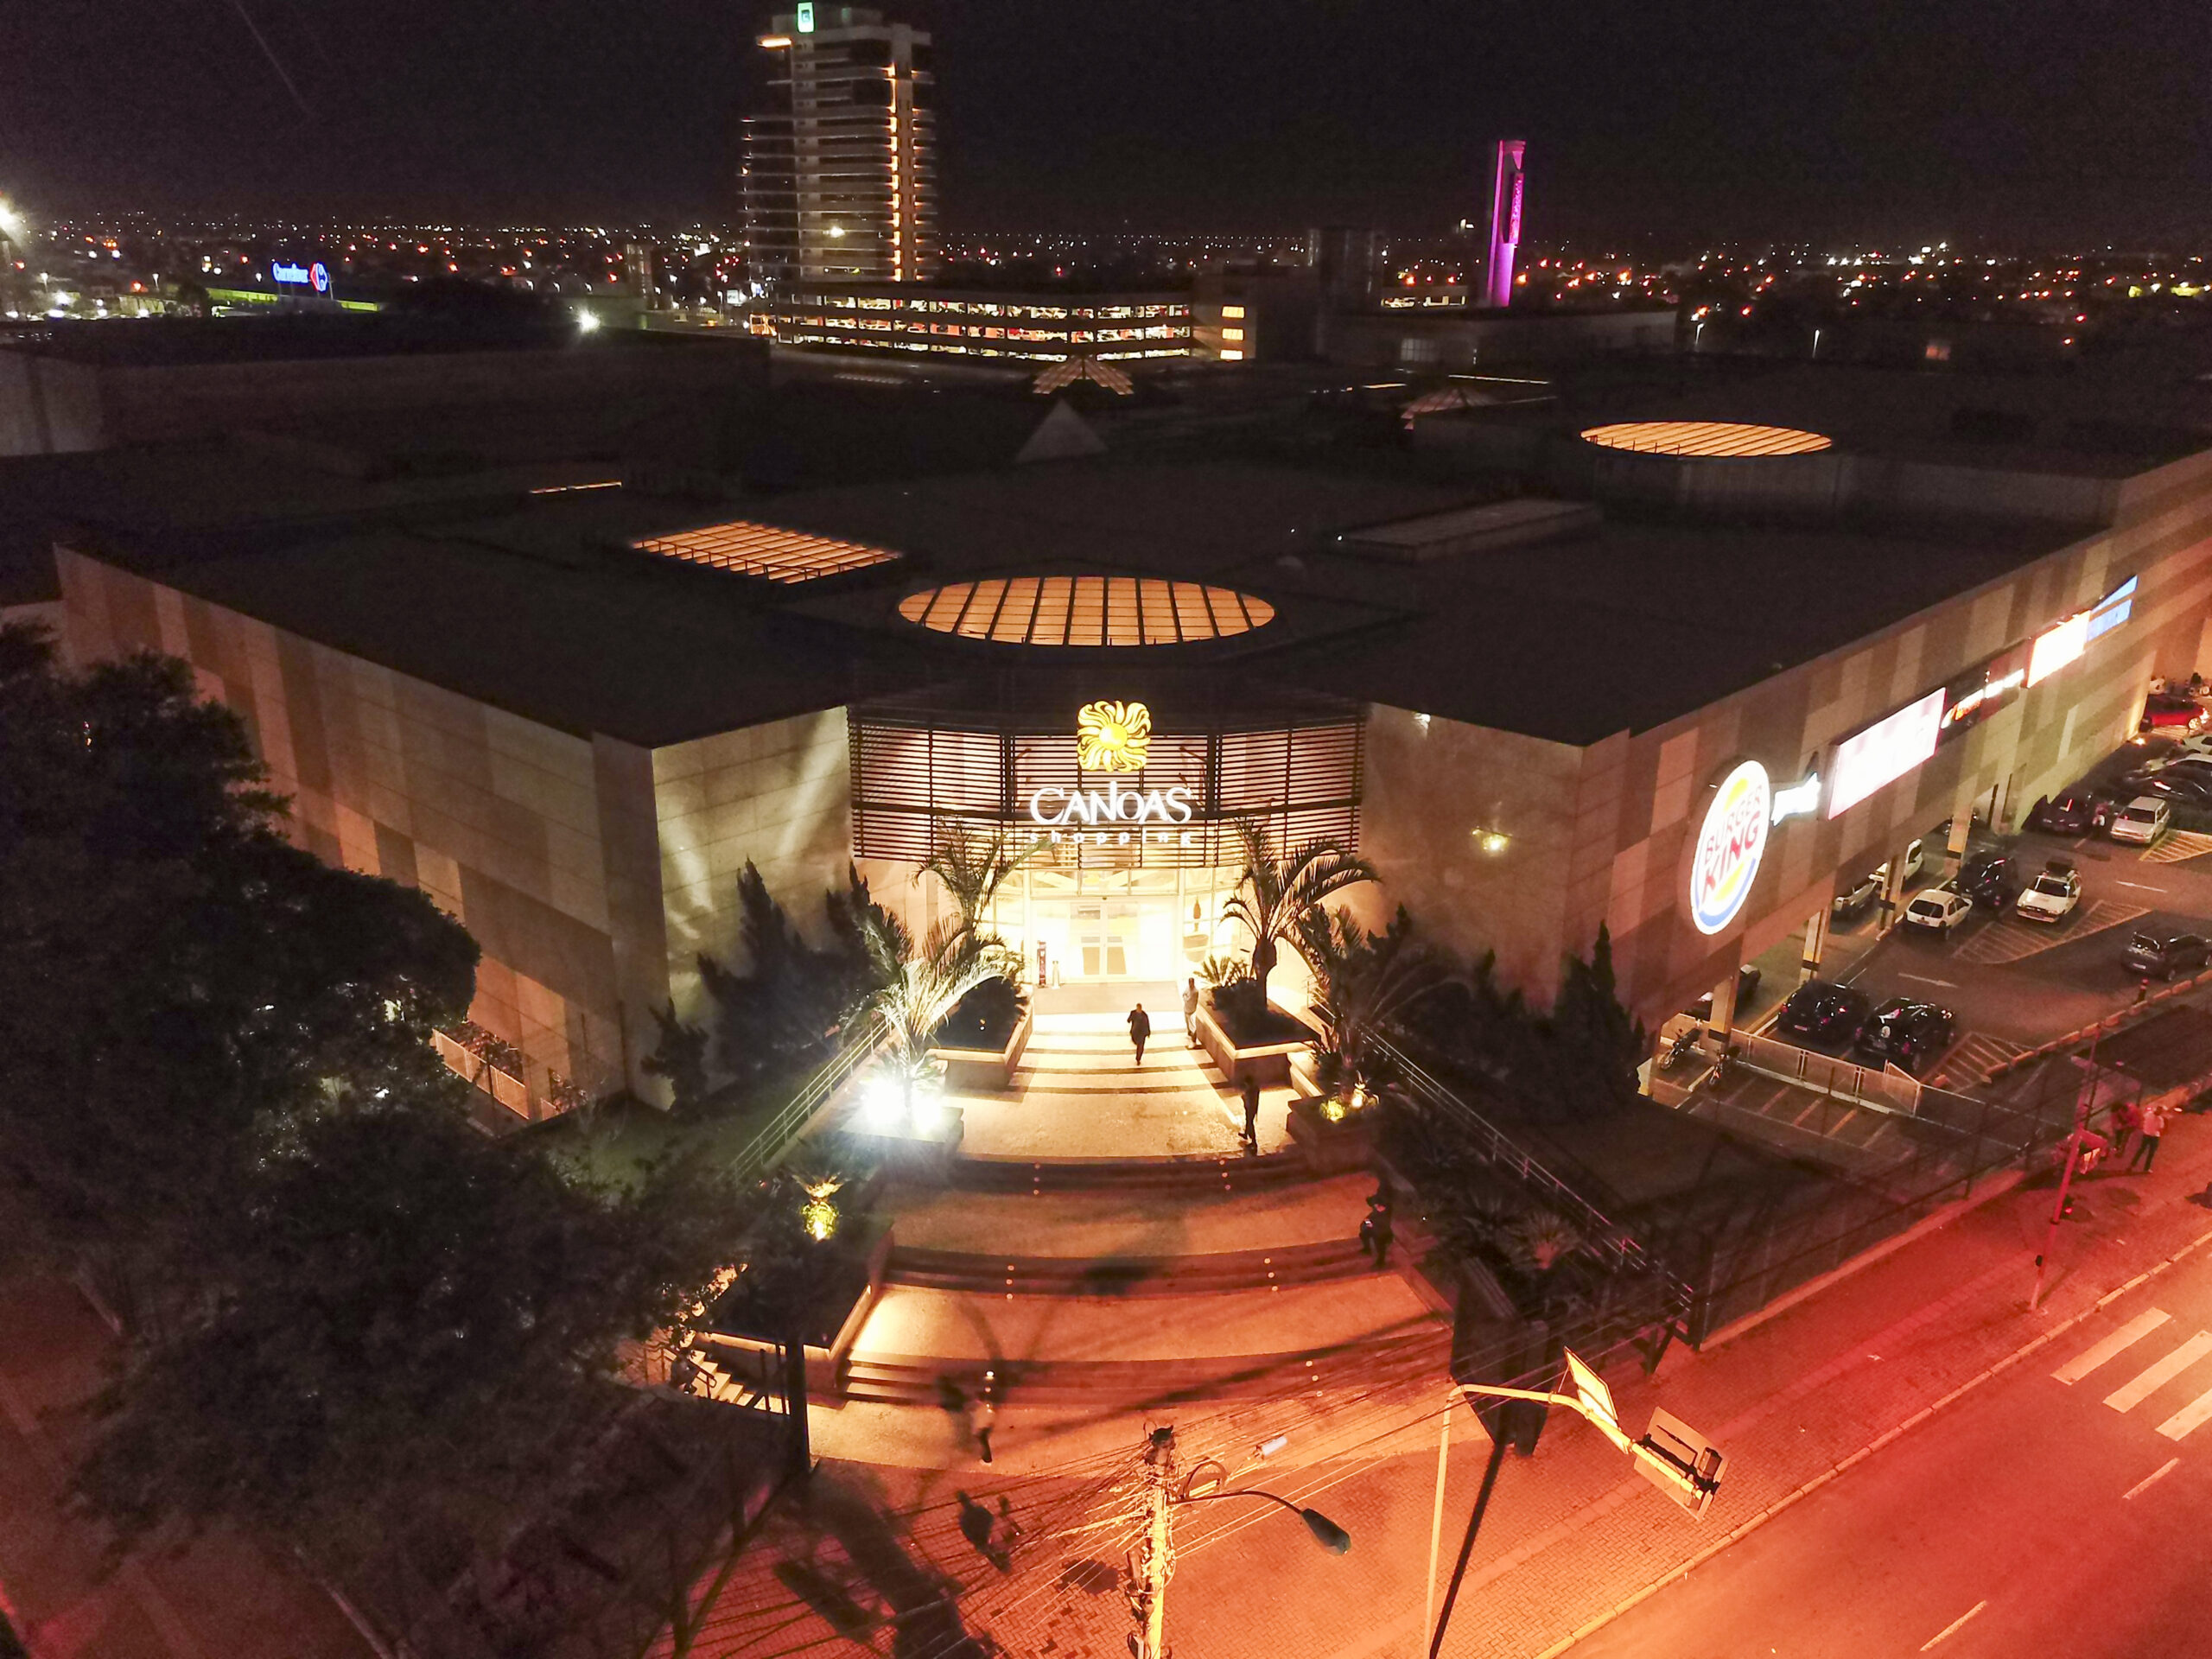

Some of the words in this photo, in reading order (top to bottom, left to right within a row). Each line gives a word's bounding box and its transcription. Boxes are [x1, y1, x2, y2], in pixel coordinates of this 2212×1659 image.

[1030, 781, 1192, 825] CANOAS
[1705, 785, 1762, 865] BURGER
[1030, 830, 1192, 846] shopping
[1702, 810, 1760, 905] KING
